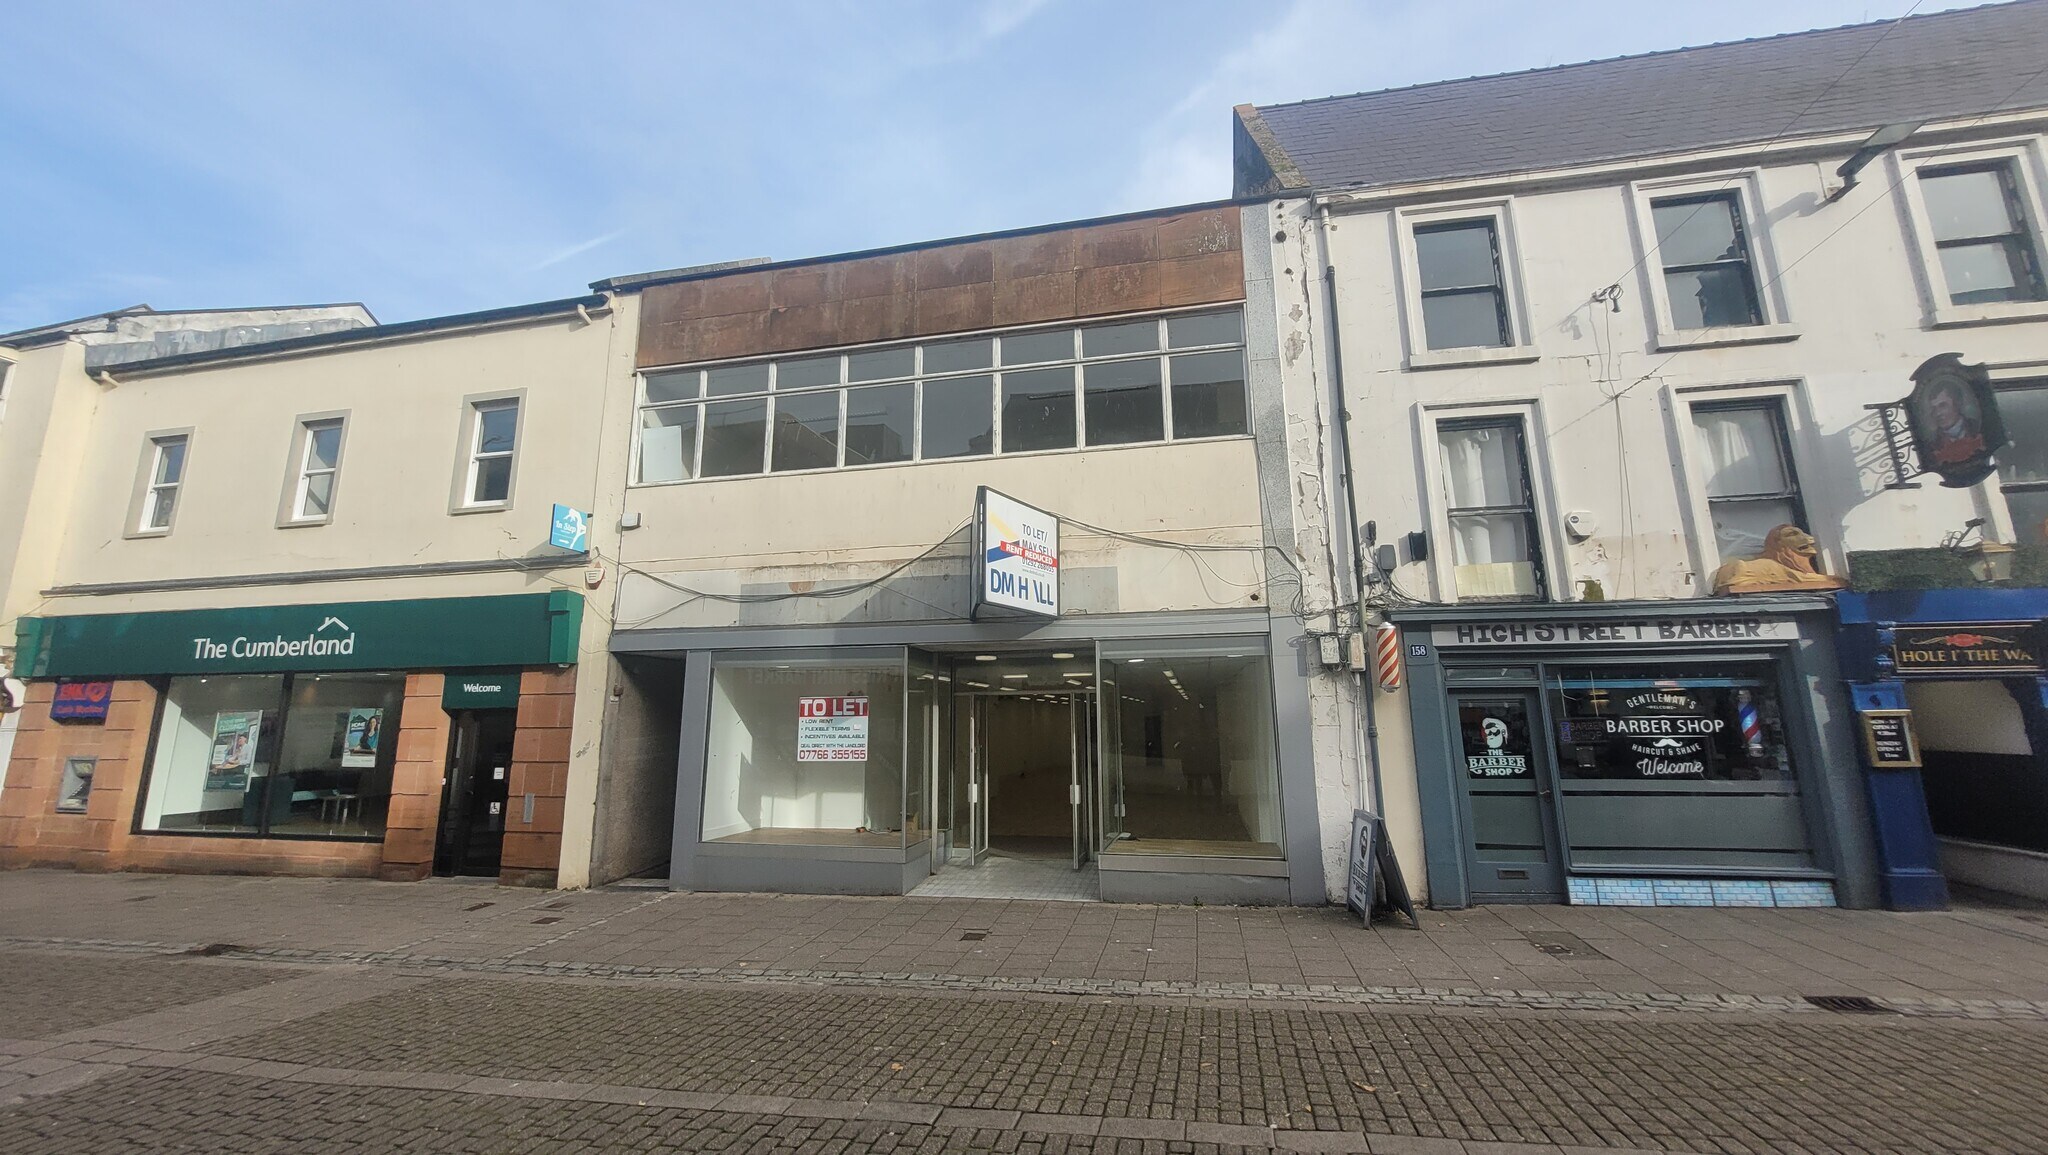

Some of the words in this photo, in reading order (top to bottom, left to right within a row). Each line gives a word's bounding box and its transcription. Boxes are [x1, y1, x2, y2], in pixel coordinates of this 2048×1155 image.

[563, 522, 577, 534] Step
[1022, 523, 1032, 536] TO
[1022, 539, 1037, 552] MAY
[1005, 543, 1023, 556] RENT
[1024, 548, 1053, 564] REDUCED
[990, 568, 1015, 597] DM
[1456, 622, 1528, 644] HIGH
[1534, 622, 1647, 642] STREET
[1659, 619, 1762, 640] BARBER
[193, 636, 228, 661] The
[230, 631, 356, 659] Cumberland
[1410, 645, 1426, 656] 158
[1902, 650, 1946, 662] HOLE
[1963, 650, 2000, 662] THE
[463, 683, 502, 693] Welcome
[800, 699, 826, 716] TO
[832, 698, 868, 716] LET
[1626, 692, 1698, 710] GENTLEMAN'S
[1606, 720, 1673, 733] BARBER
[1677, 719, 1725, 733] SHOP
[799, 750, 829, 760] 07766
[831, 750, 866, 760] 355155
[1631, 743, 1665, 756] HAIRCUT
[1676, 743, 1702, 755] SHAVE
[1468, 757, 1526, 768] BARBER
[1636, 757, 1704, 776] Welcome
[1485, 768, 1513, 776] SHOP
